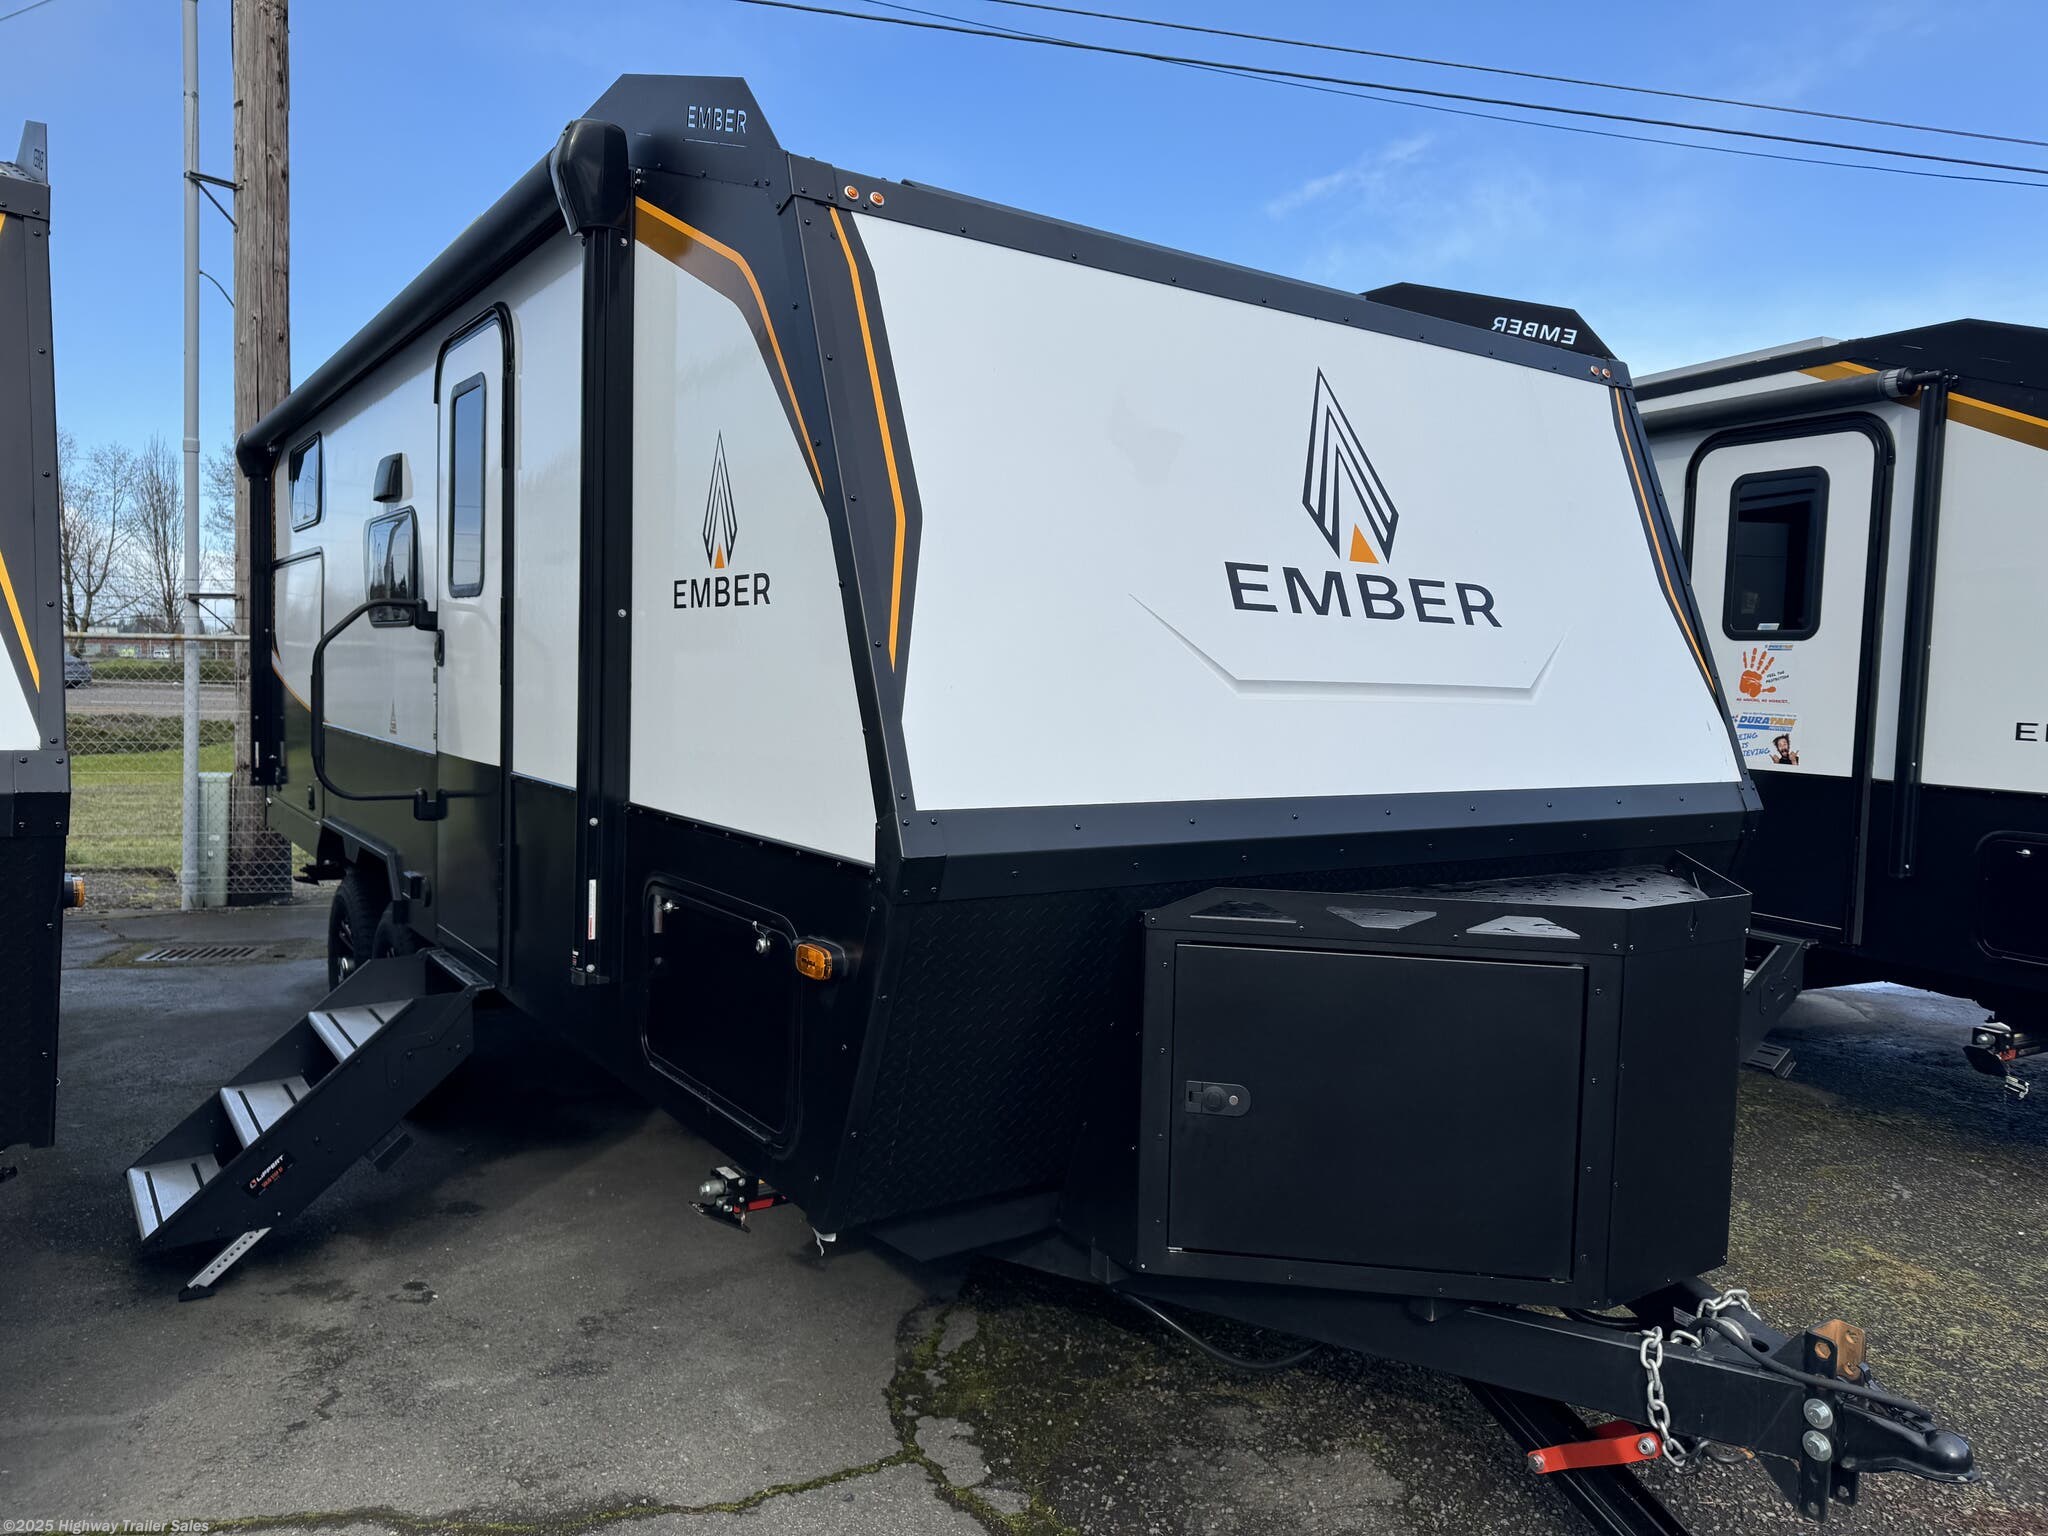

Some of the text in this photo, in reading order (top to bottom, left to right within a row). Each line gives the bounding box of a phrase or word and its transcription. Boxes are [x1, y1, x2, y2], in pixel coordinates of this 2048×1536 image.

[687, 105, 747, 134] EMBER
[673, 572, 771, 609] EMBER
[1224, 561, 1503, 628] EMBER
[2015, 722, 2048, 742] E
